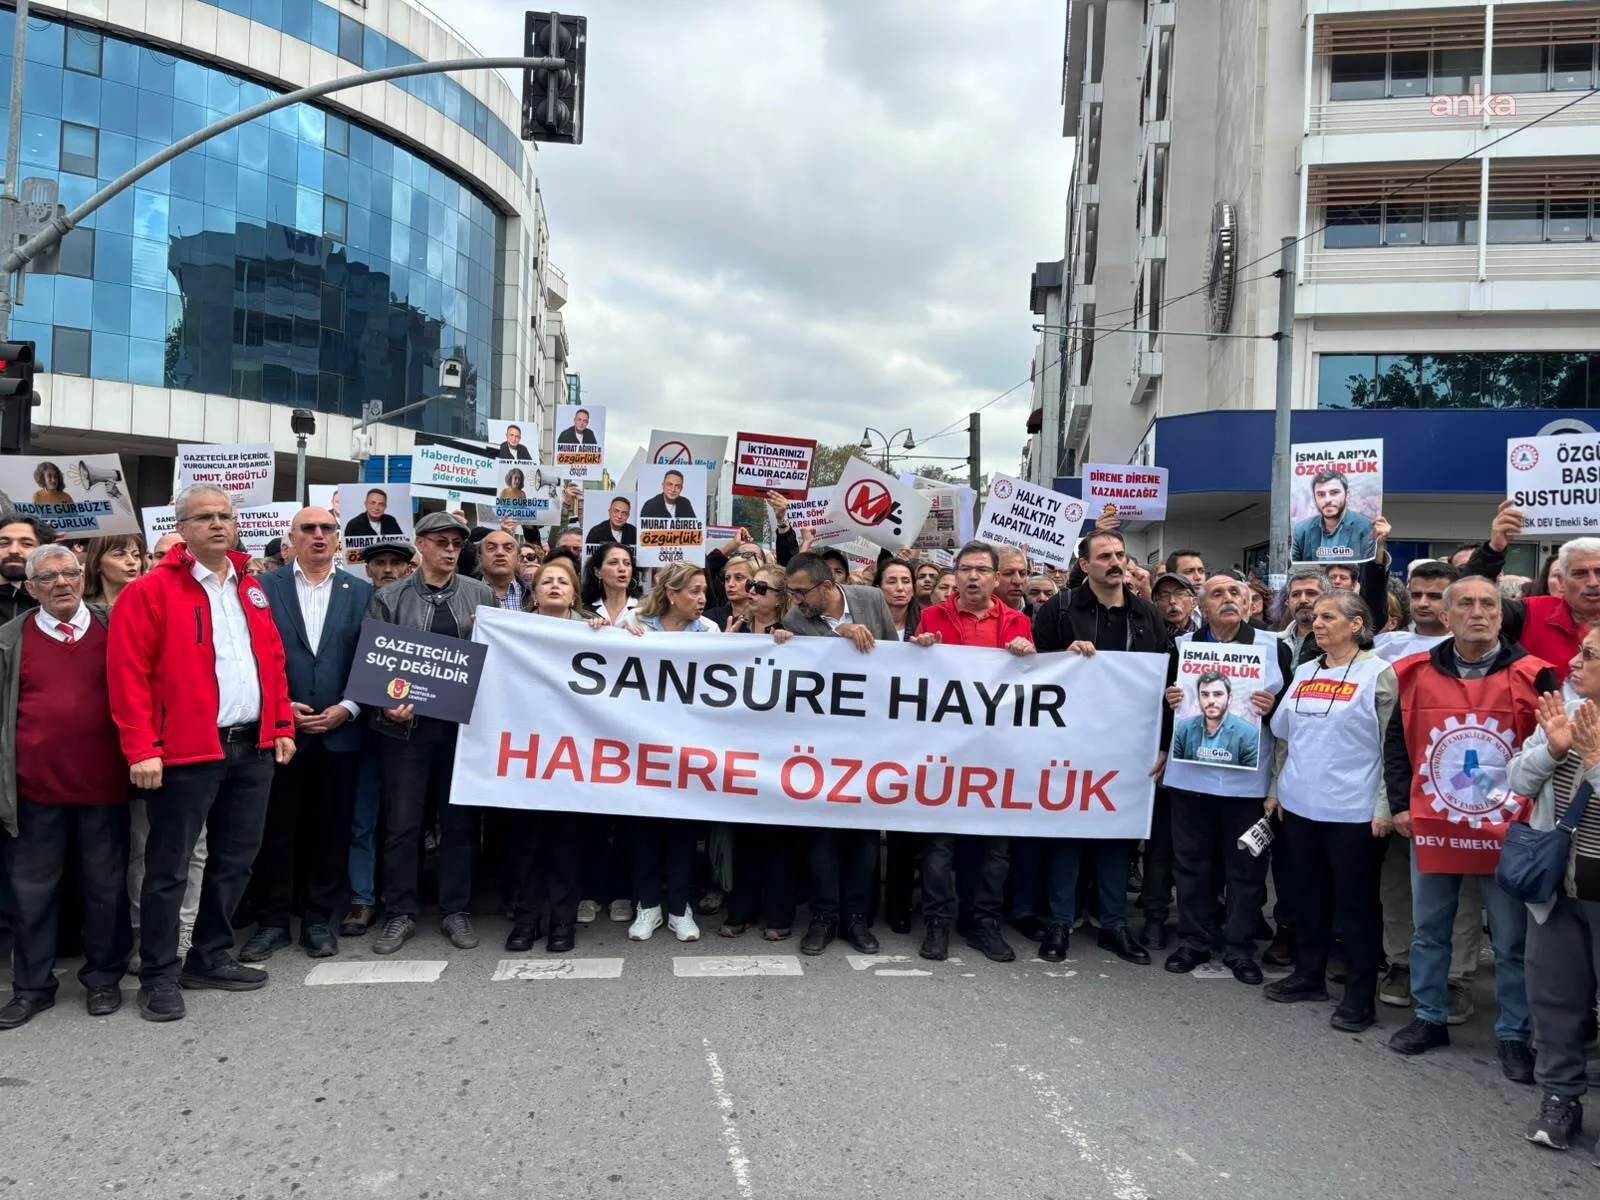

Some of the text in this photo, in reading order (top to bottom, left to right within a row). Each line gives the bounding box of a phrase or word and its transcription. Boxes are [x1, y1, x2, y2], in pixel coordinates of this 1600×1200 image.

[184, 453, 239, 461] GAZETECİLER
[748, 443, 805, 458] İKTİDARINIZI
[1295, 449, 1378, 462] İSMAİL ARI'YA
[183, 461, 272, 470] VURGUNCULAR DIŞARIDA!
[421, 449, 473, 465] Haberden
[475, 459, 493, 469] çok
[559, 454, 601, 464] özgürlük!
[752, 456, 799, 469] YAYINDAN
[192, 469, 268, 482] UMUT, ÖRGÜTLÜ
[433, 463, 477, 477] ADLİYEYE
[1295, 460, 1378, 476] ÖZGÜRLÜK
[1562, 466, 1600, 484] BAS
[432, 472, 479, 485] gider olduk
[1090, 470, 1160, 484] DİRENE DİRENE
[217, 482, 254, 491] SINDA!
[1091, 486, 1158, 498] KAZANACAĞIZ
[1015, 488, 1062, 513] HALK TV
[1514, 488, 1600, 507] SUSTURU
[15, 500, 111, 514] NADİYE GÜRBÜZ'E
[1010, 503, 1056, 528] HALKTIR
[1537, 517, 1553, 528] DEV
[1555, 516, 1581, 527] Emekli
[1583, 516, 1598, 527] Sen
[641, 518, 702, 530] MURAT AĞIREL'e
[990, 512, 1065, 547] KAPATILAMAZ.
[643, 531, 701, 546] özgürlük!
[375, 636, 470, 666] GAZETECİLİK
[1183, 649, 1261, 665] İSMAİL ARI'YA
[366, 652, 469, 685] SUÇ DEĞİLDİR
[1182, 660, 1261, 679] ÖZGÜRLÜK
[568, 651, 1067, 728] SANSÜRE HAYIR
[497, 731, 1120, 812] HABERE ÖZGÜRLÜK
[1415, 835, 1502, 850] DEV EMEKL
